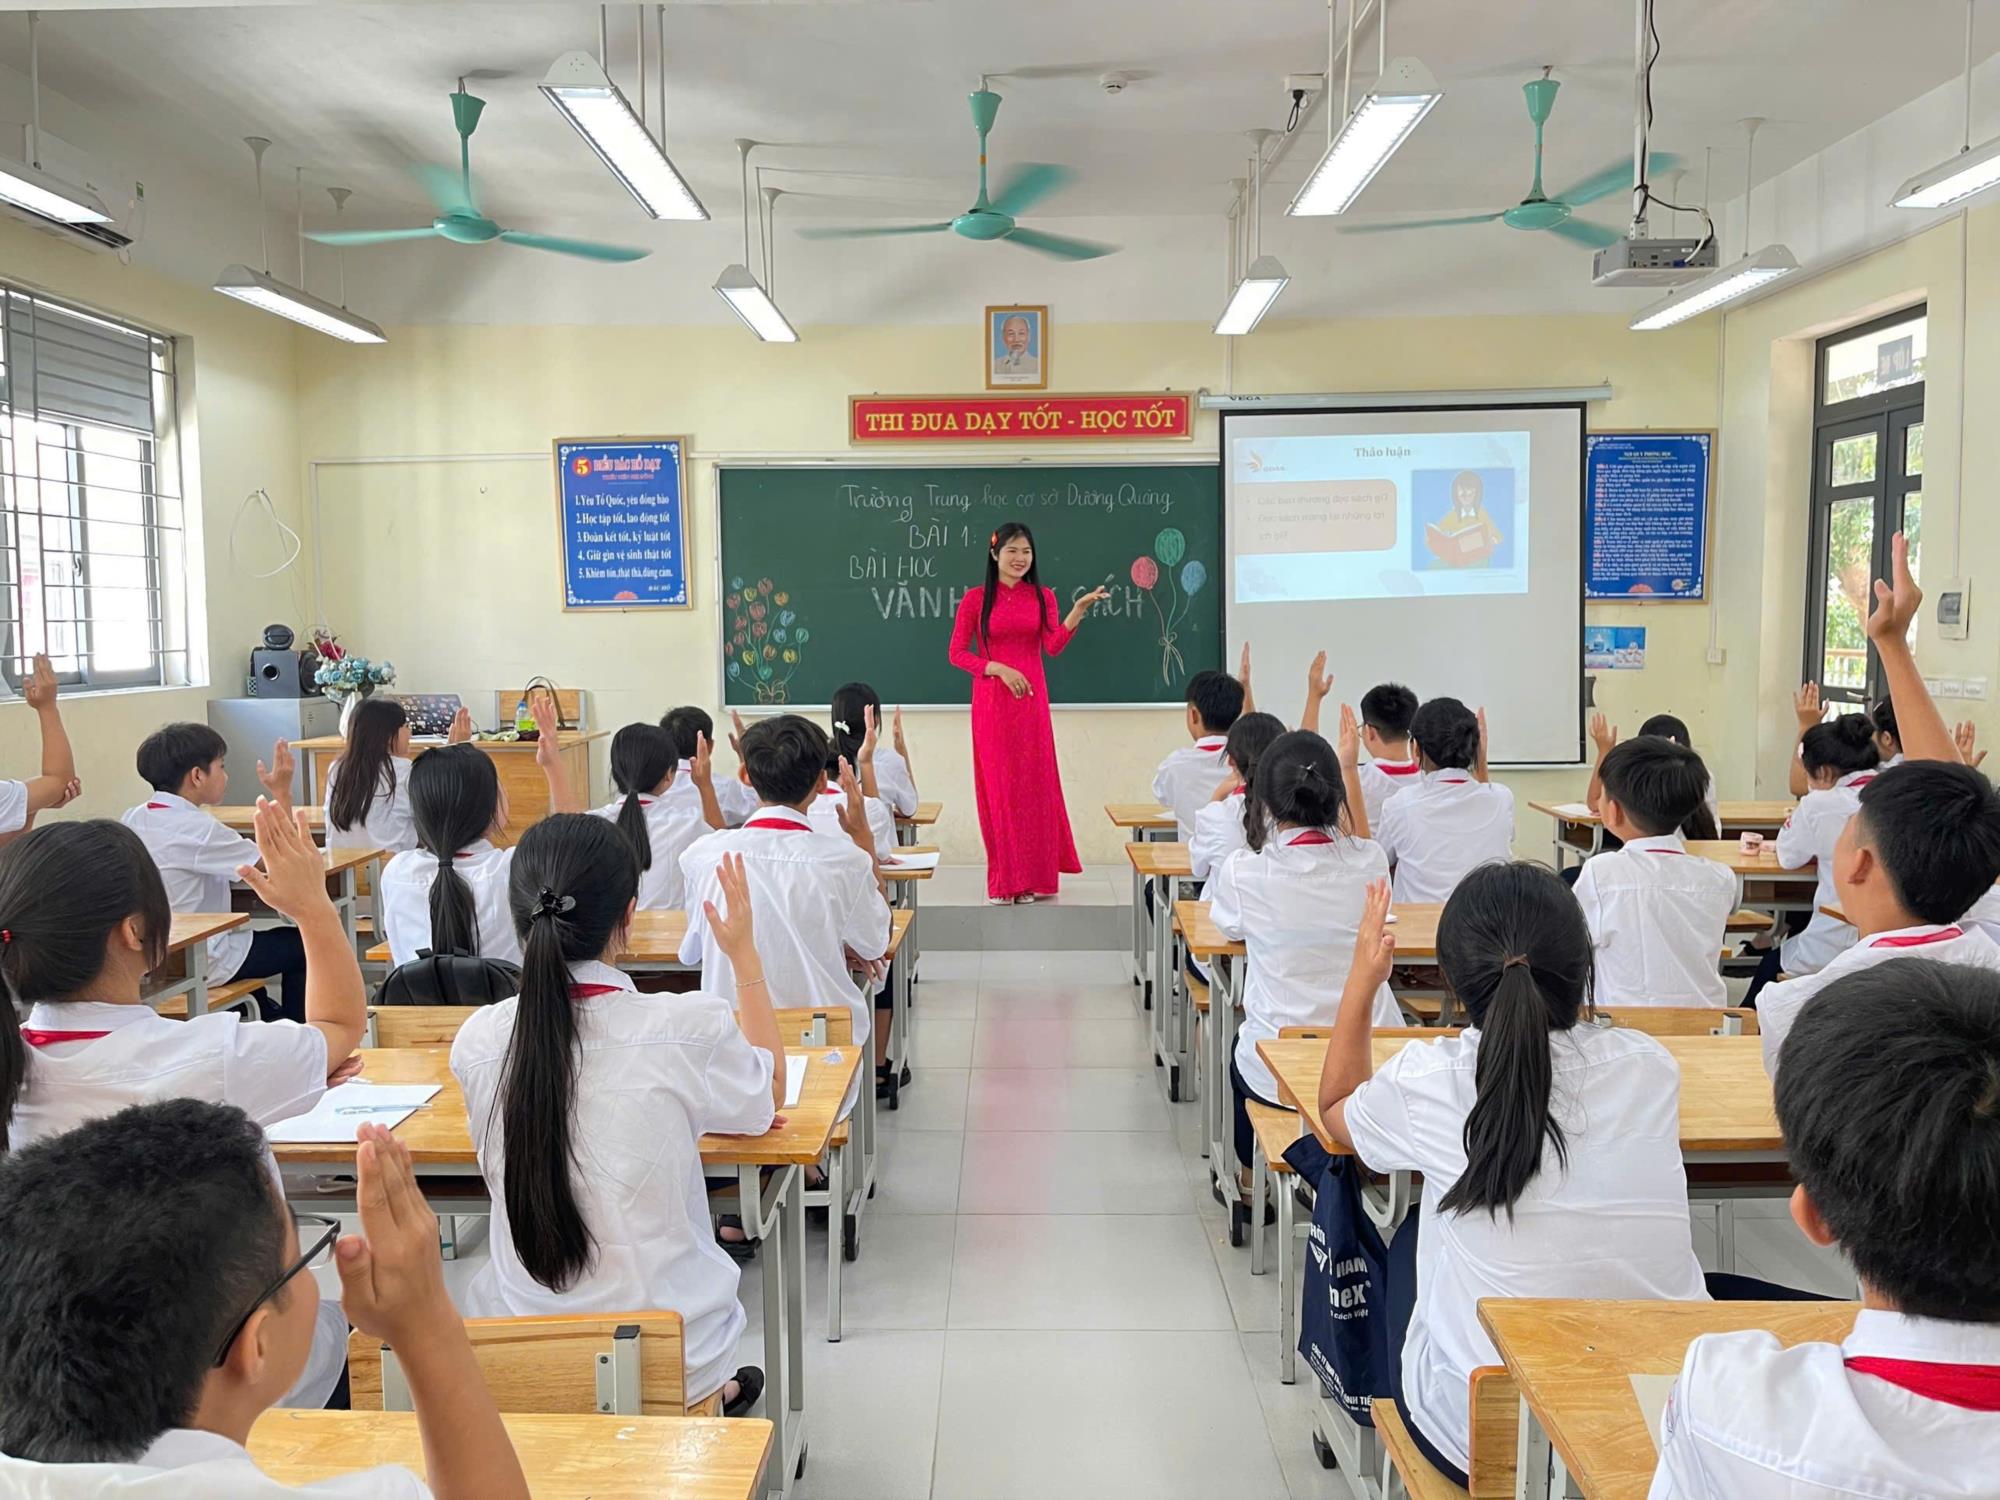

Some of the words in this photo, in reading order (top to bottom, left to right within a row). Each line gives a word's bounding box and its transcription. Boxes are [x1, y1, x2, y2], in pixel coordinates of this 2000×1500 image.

[865, 412, 905, 432] THI
[911, 412, 960, 431] ĐUA
[964, 411, 1013, 435] DẠY
[1018, 402, 1063, 430] TỐT
[1080, 409, 1127, 433] HỌC
[1131, 400, 1176, 428] TỐT
[1353, 446, 1383, 458] Thảo
[1385, 445, 1411, 459] luận
[577, 458, 588, 475] 5
[596, 492, 605, 506] Tổ
[657, 493, 670, 505] bào
[924, 484, 971, 512] Trung
[979, 483, 1009, 508] học
[1016, 492, 1035, 508] cơ
[599, 512, 611, 526] tập
[627, 512, 638, 523] lao
[640, 512, 659, 525] động
[660, 511, 670, 523] tốt
[605, 531, 617, 542] kết
[644, 531, 659, 542] luật
[660, 530, 671, 542] tốt
[909, 517, 949, 550] BÀI
[586, 549, 601, 560] Giữ
[602, 549, 615, 563] gìn
[616, 551, 625, 562] vệ
[627, 549, 642, 560] sinh
[644, 549, 659, 561] thật
[661, 548, 672, 560] tốt
[849, 547, 887, 580] BÀI
[1359, 1393, 1373, 1406] TIẾ
